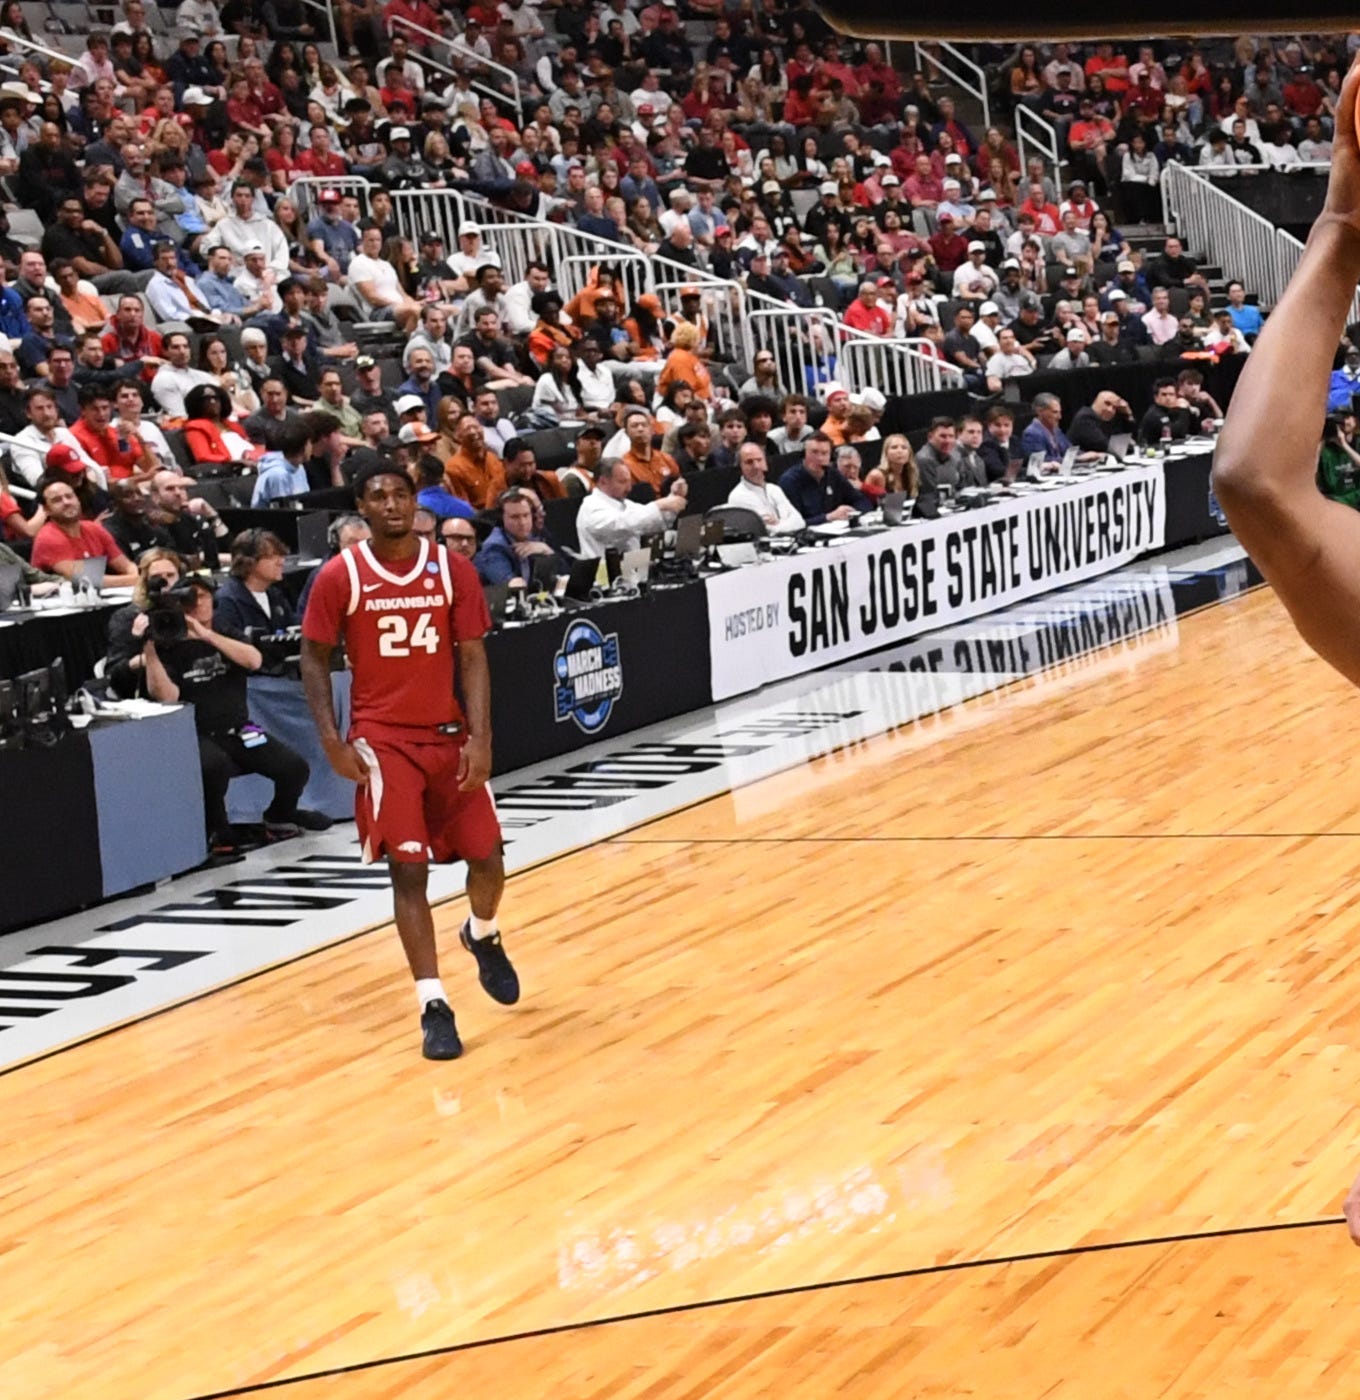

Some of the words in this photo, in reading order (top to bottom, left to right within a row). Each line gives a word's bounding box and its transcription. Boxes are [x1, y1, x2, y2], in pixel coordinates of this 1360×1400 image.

[787, 561, 849, 657] SAN
[860, 537, 937, 636] JOSE
[945, 514, 1021, 608] STATE
[1027, 477, 1158, 581] UNIVERSITY
[364, 594, 444, 611] ARKANSAS
[377, 613, 440, 657] 24
[724, 608, 765, 641] HOSTED
[766, 602, 780, 629] BY
[566, 646, 603, 679] MARCH
[574, 665, 620, 700] MADNESS
